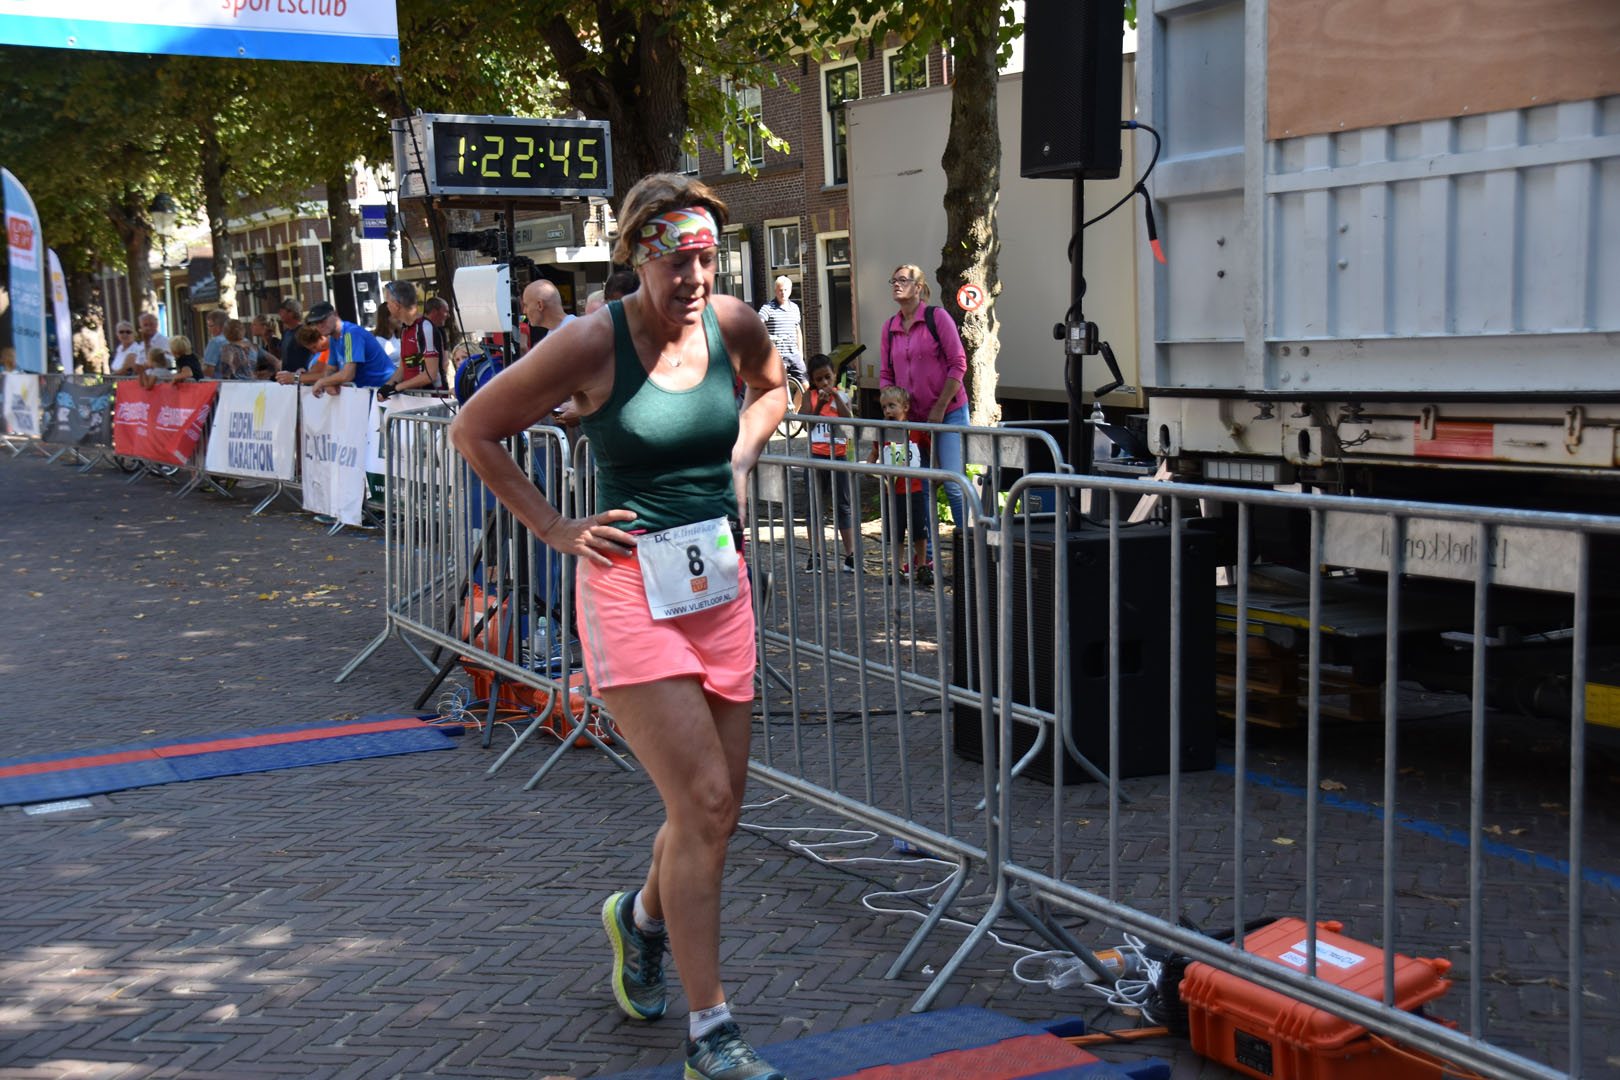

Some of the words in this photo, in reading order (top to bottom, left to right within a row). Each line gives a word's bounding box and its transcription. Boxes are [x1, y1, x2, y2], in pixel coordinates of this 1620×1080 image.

[458, 135, 599, 180] 1:22:45
[228, 441, 275, 472] MARATHON
[686, 544, 705, 577] 8
